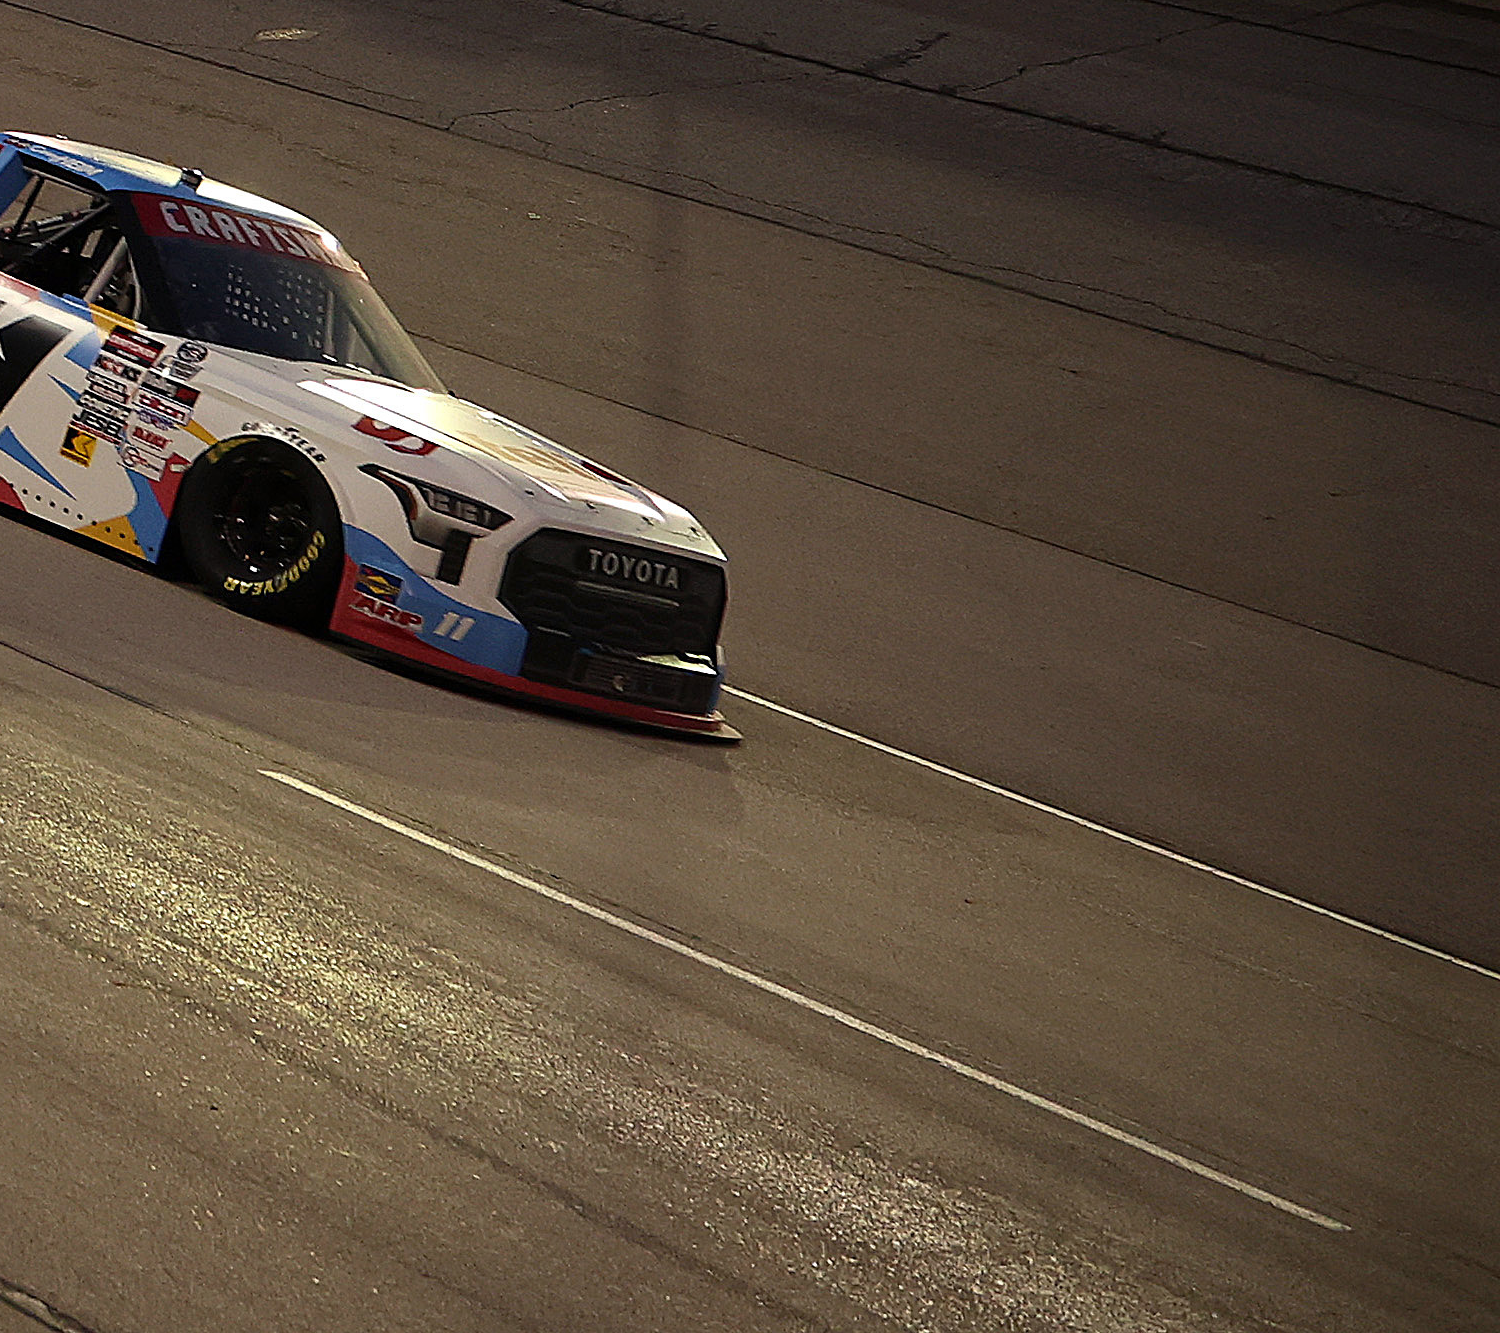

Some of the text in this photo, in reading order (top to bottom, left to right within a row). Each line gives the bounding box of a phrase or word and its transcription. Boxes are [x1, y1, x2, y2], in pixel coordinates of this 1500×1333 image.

[158, 200, 348, 271] CRAFTSM
[223, 529, 327, 596] GOODYEAR
[587, 547, 680, 590] TOYOTA
[348, 593, 423, 631] ARP
[432, 611, 477, 642] 11
